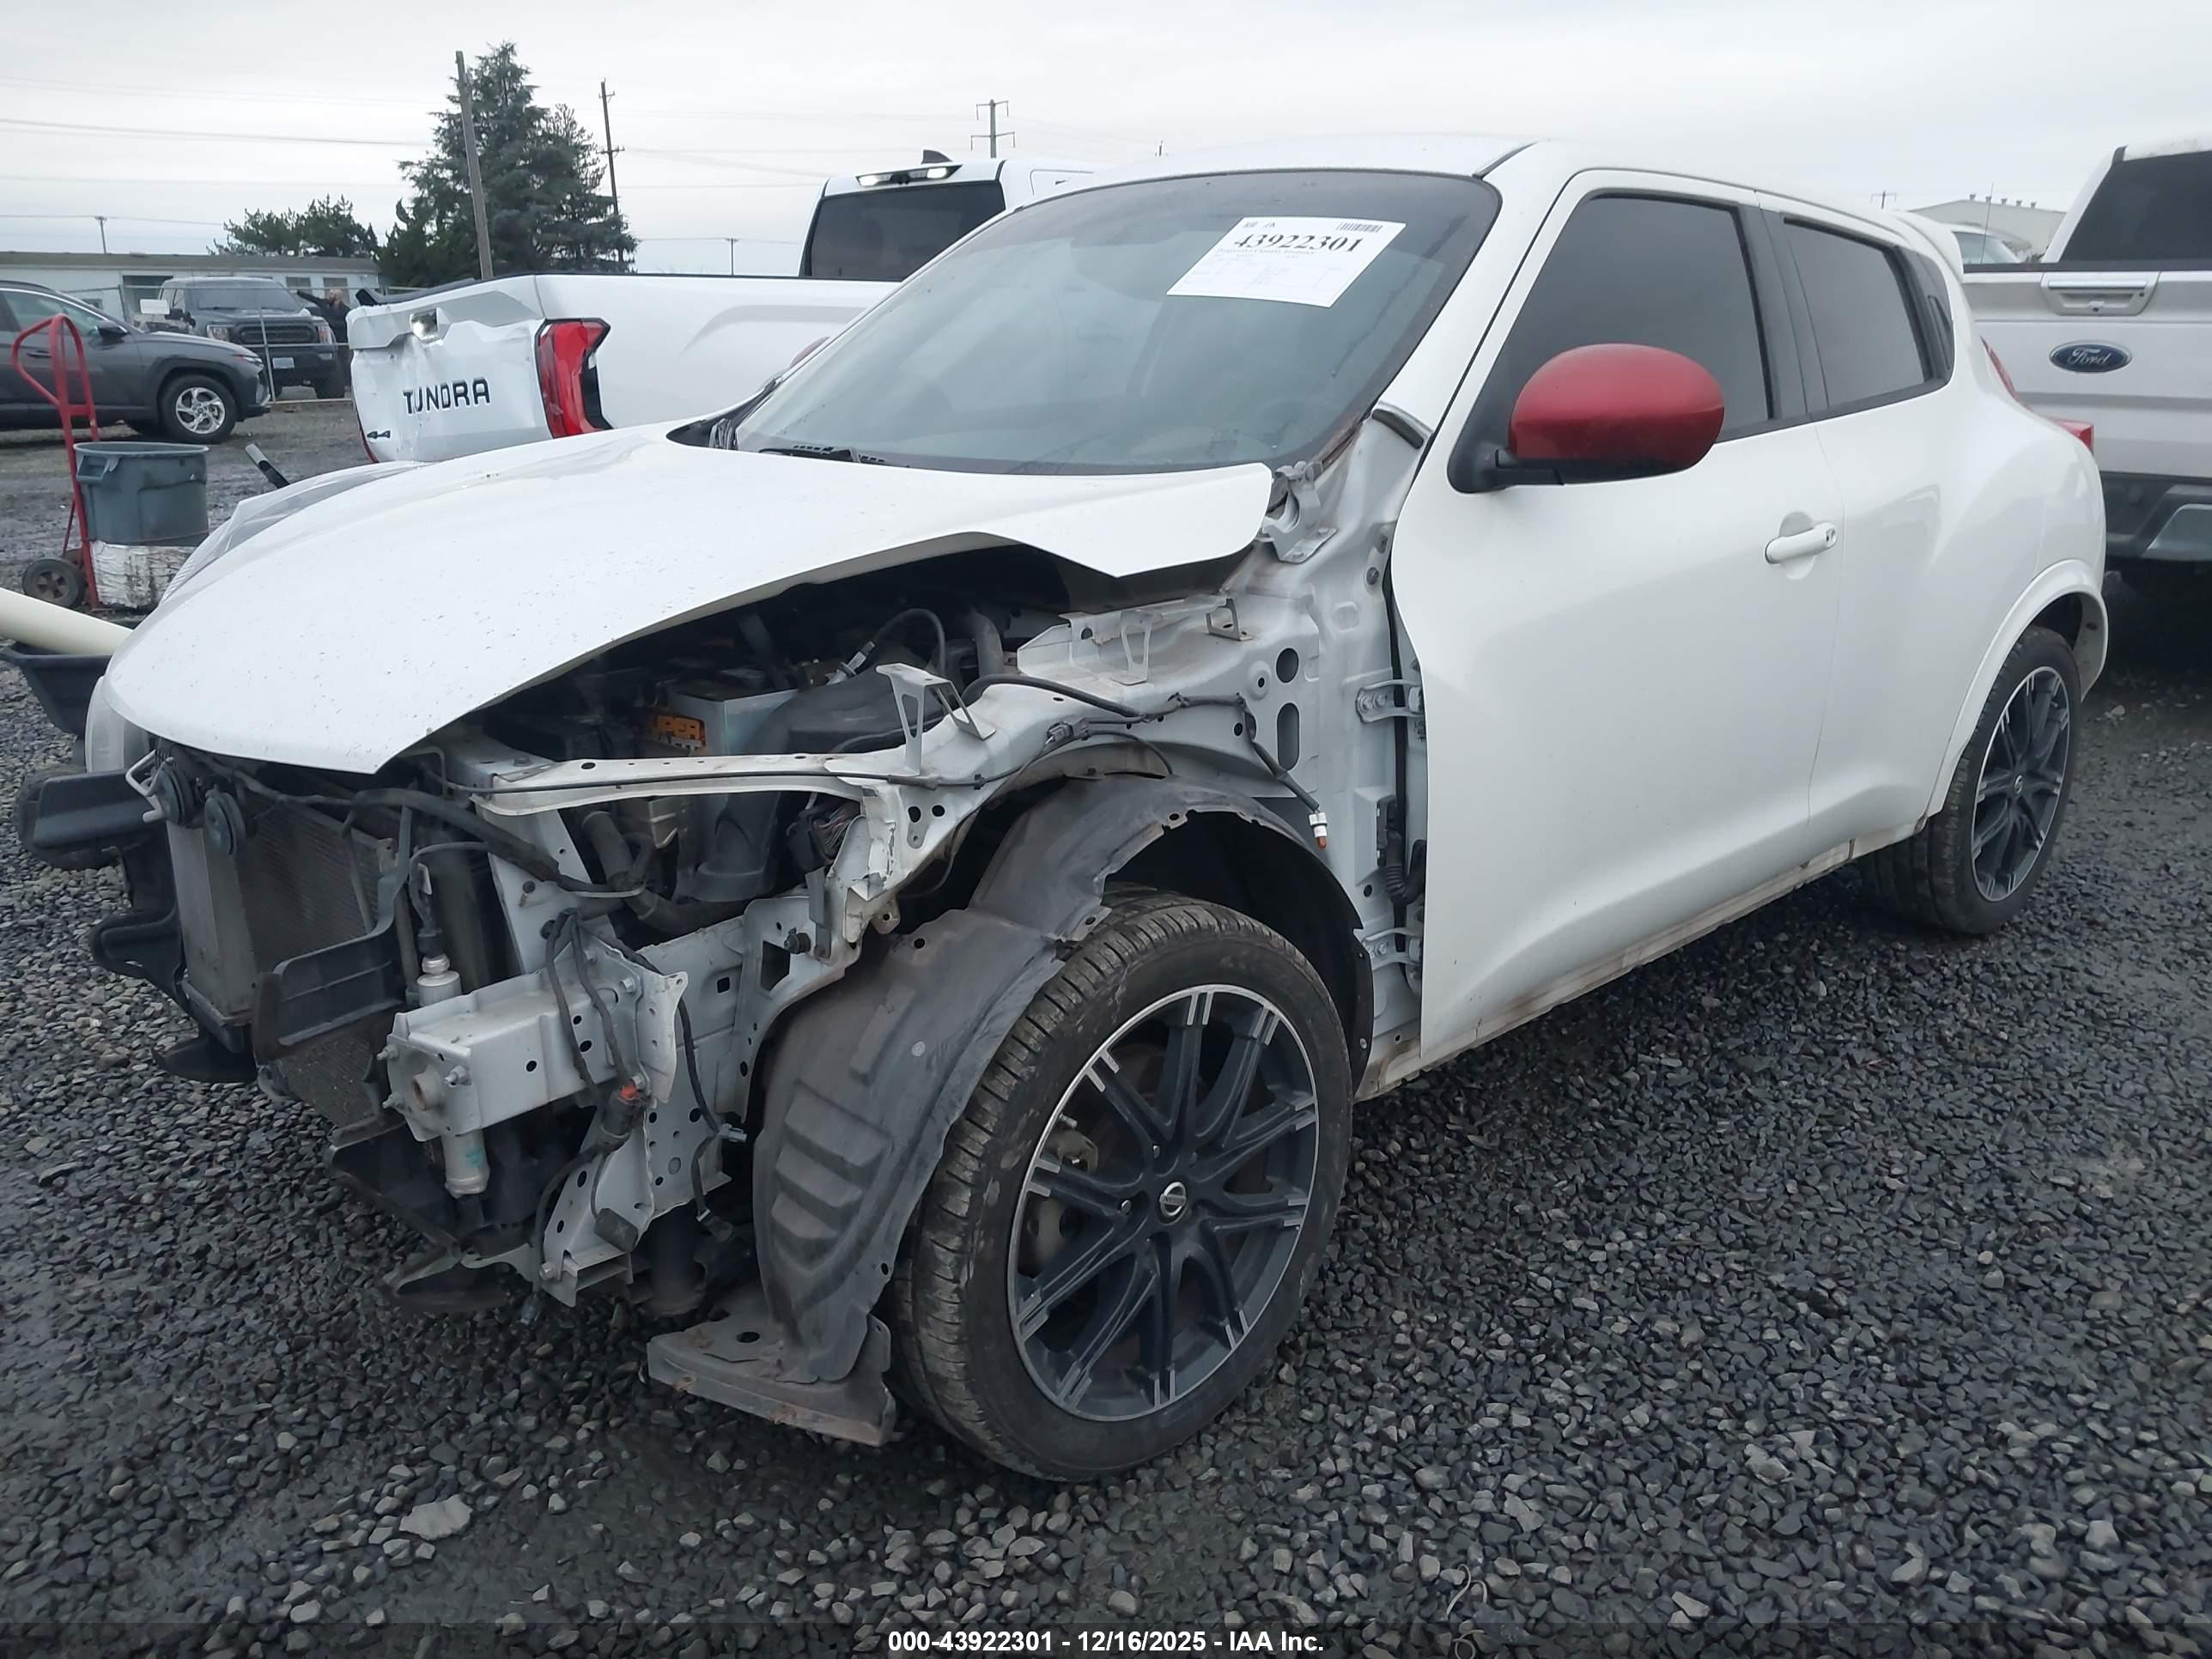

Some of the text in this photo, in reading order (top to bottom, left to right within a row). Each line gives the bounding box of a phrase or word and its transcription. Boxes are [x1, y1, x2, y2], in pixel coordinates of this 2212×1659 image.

[1234, 233, 1364, 252] 43922301
[2068, 348, 2112, 365] Ford
[403, 377, 490, 414] TUNDRA
